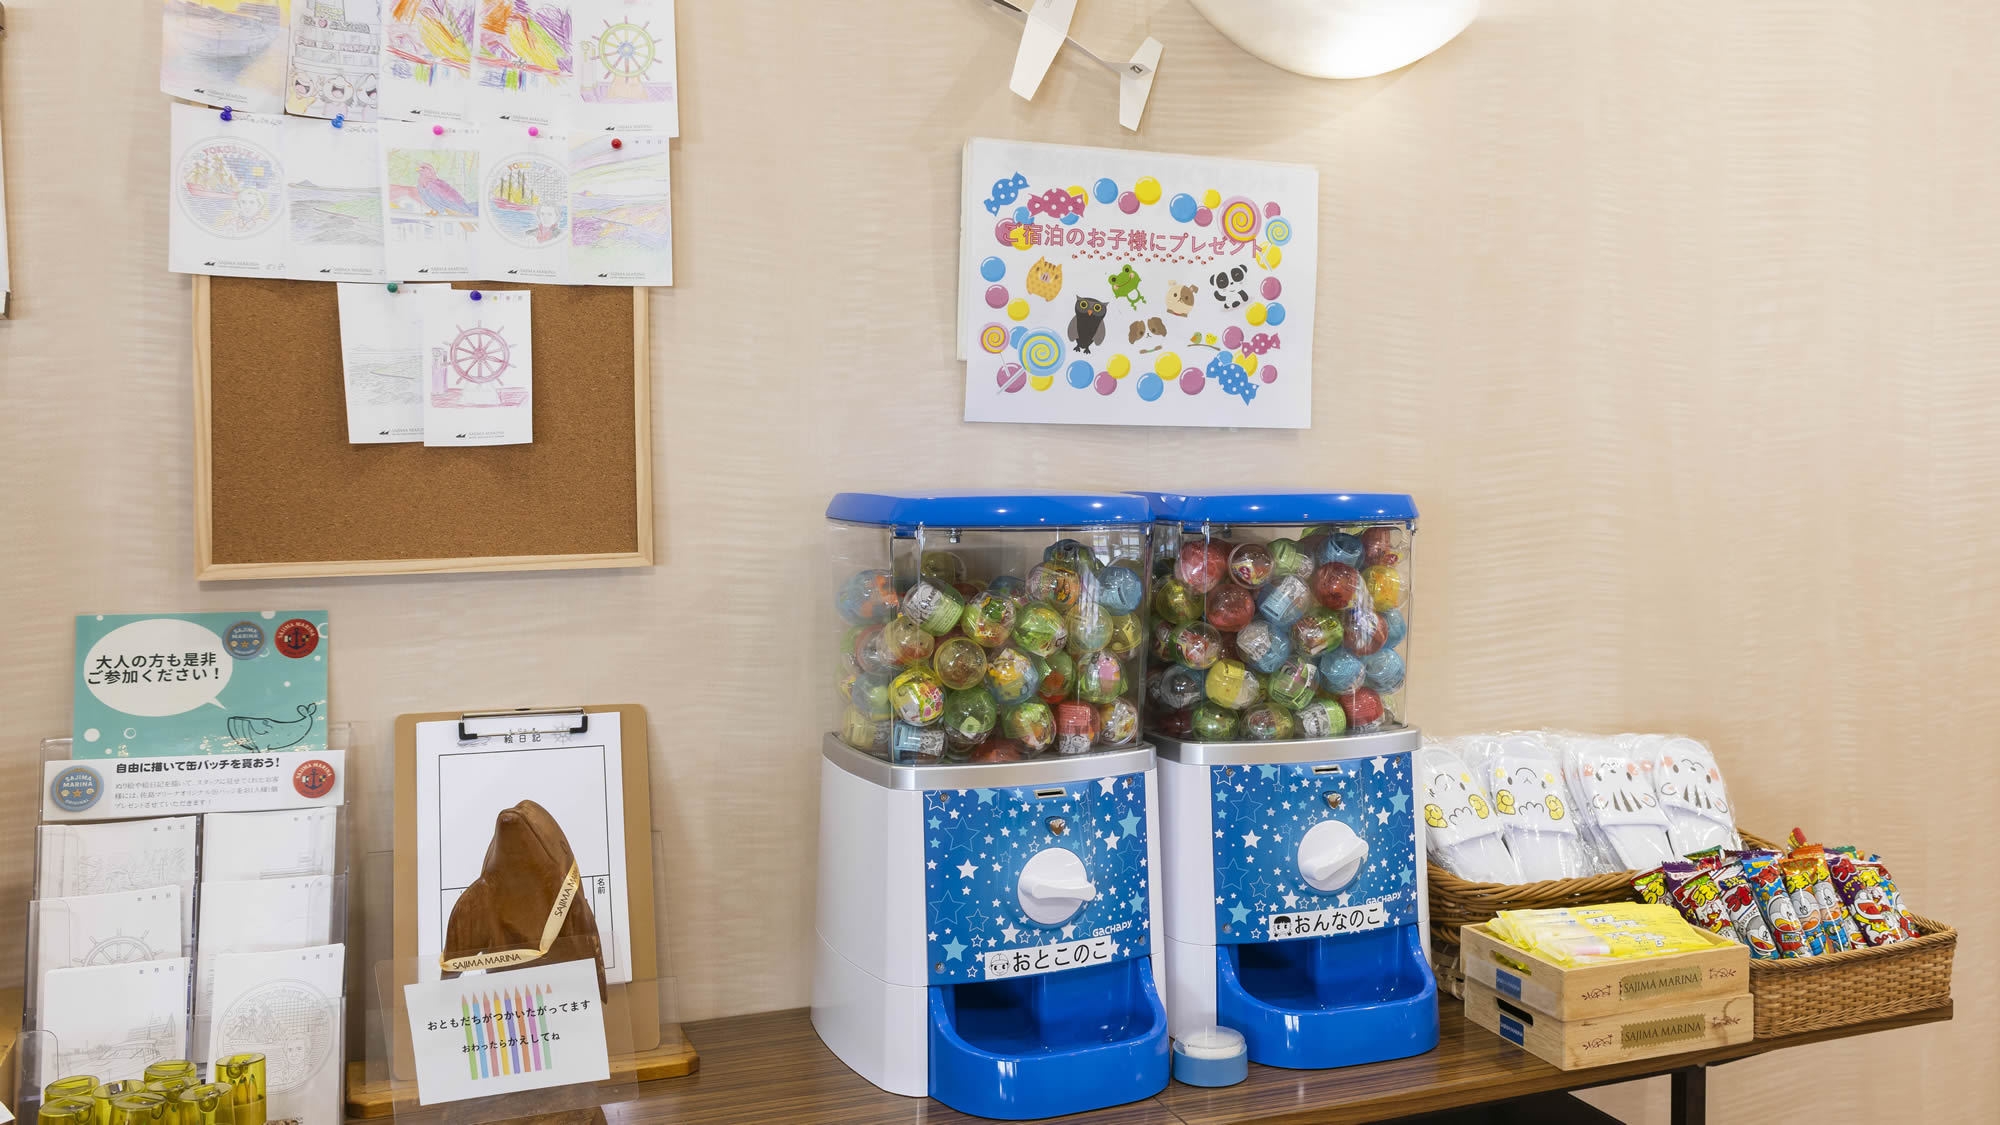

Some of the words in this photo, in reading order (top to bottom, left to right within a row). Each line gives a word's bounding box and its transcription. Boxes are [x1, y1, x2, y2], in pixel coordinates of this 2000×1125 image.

[1003, 222, 1264, 259] ご宿泊のお子様にプレゼント
[96, 652, 217, 669] 大人の方も是非
[554, 887, 573, 917] SAJIMA
[1294, 906, 1382, 935] おんなのこ
[453, 957, 484, 969] SAJIMA
[485, 953, 522, 964] MARINA
[1012, 939, 1109, 973] おとこのこ
[1623, 977, 1657, 994] SAJIMA
[1658, 973, 1700, 989] MARINA
[427, 999, 591, 1031] おともだちがつかいたがってます
[462, 1031, 561, 1054] おわったらかえしてね
[1625, 1026, 1659, 1042] SAJIMA
[1661, 1022, 1702, 1037] MARINA
